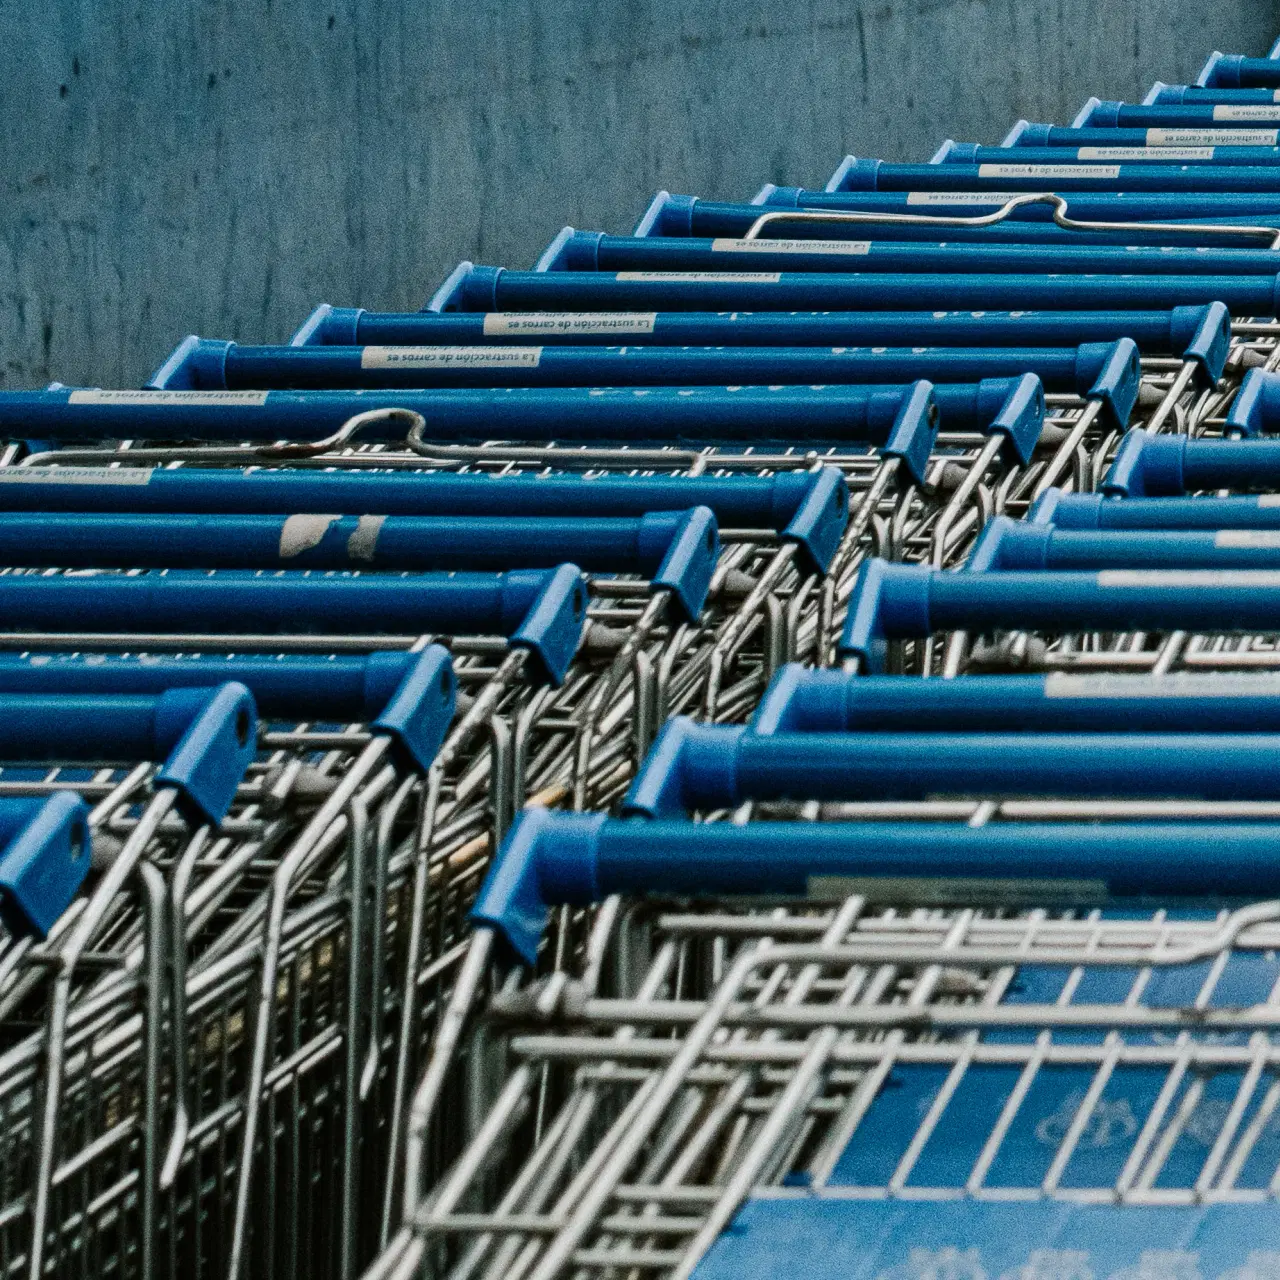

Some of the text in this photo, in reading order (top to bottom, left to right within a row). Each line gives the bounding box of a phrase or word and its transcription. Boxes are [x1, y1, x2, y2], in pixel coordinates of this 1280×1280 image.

[558, 321, 572, 330] de
[574, 320, 635, 330] sustracción
[638, 320, 650, 329] La
[439, 354, 454, 363] de
[456, 354, 519, 363] sustracción
[523, 354, 535, 363] La
